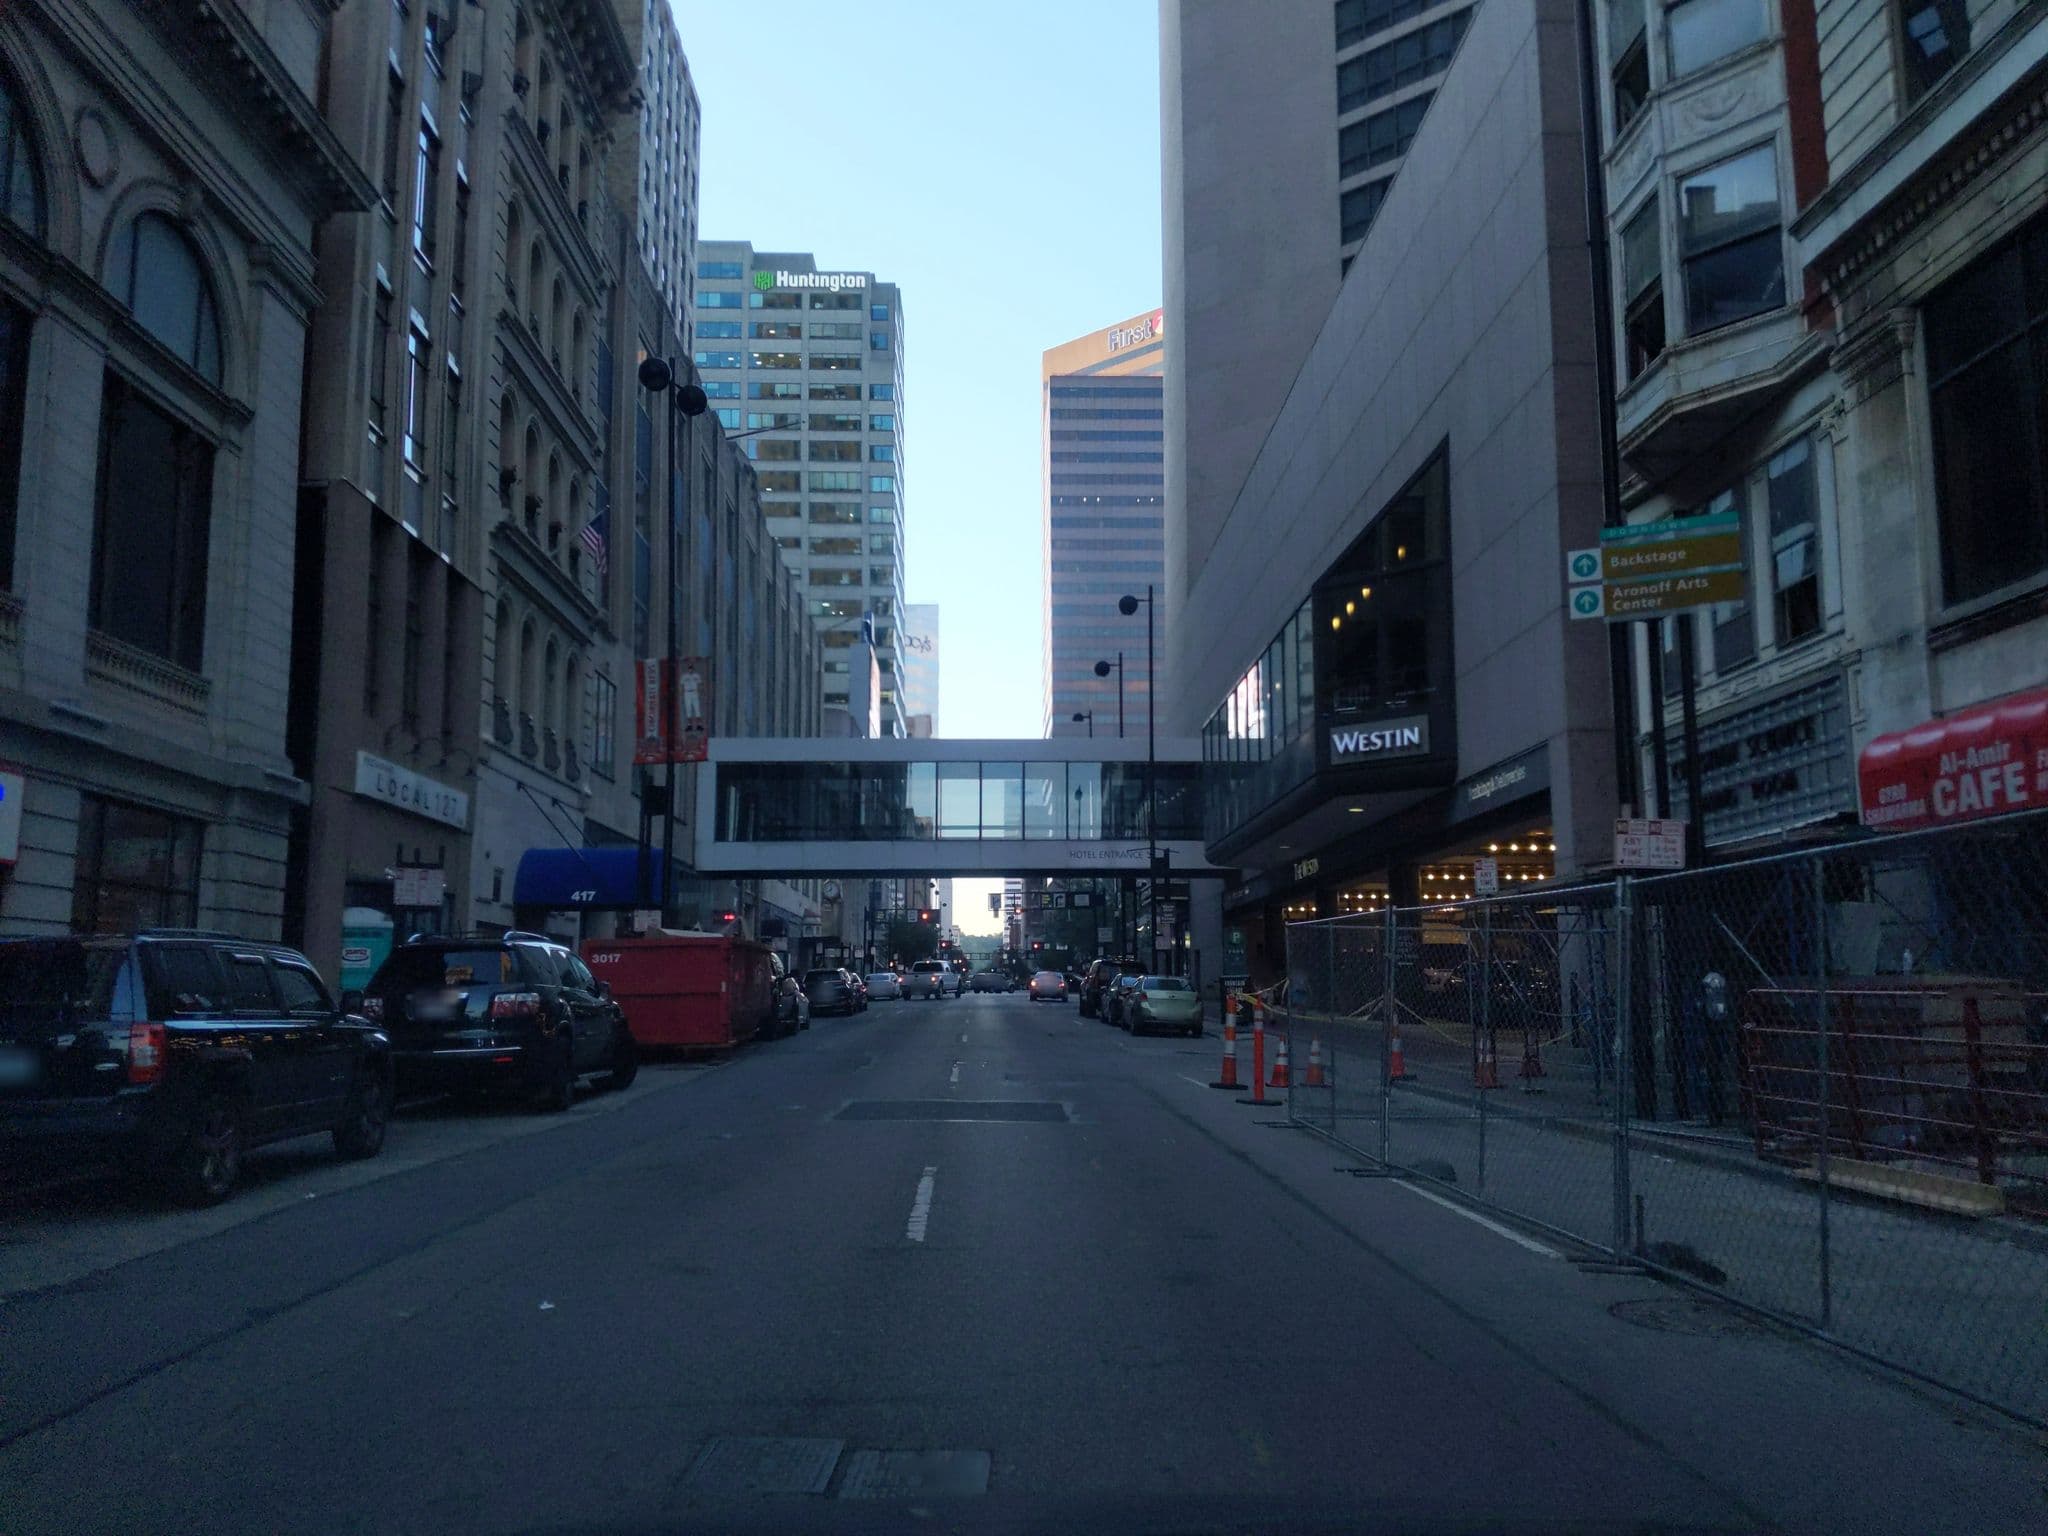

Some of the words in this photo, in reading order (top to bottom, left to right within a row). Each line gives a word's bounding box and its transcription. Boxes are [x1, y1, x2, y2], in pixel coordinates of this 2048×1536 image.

[776, 270, 866, 292] Huntington
[1107, 318, 1152, 353] First
[1610, 549, 1687, 568] Backstage
[1612, 580, 1672, 599] Aronoff
[1676, 576, 1709, 591] Arts
[1612, 597, 1662, 611] Center
[1940, 740, 2011, 775] Al-Amir
[376, 772, 430, 811] LOCAL
[1932, 761, 2029, 817] CAFE
[1069, 851, 1096, 859] HOTEL
[571, 890, 597, 902] 417
[591, 953, 622, 964] 3017
